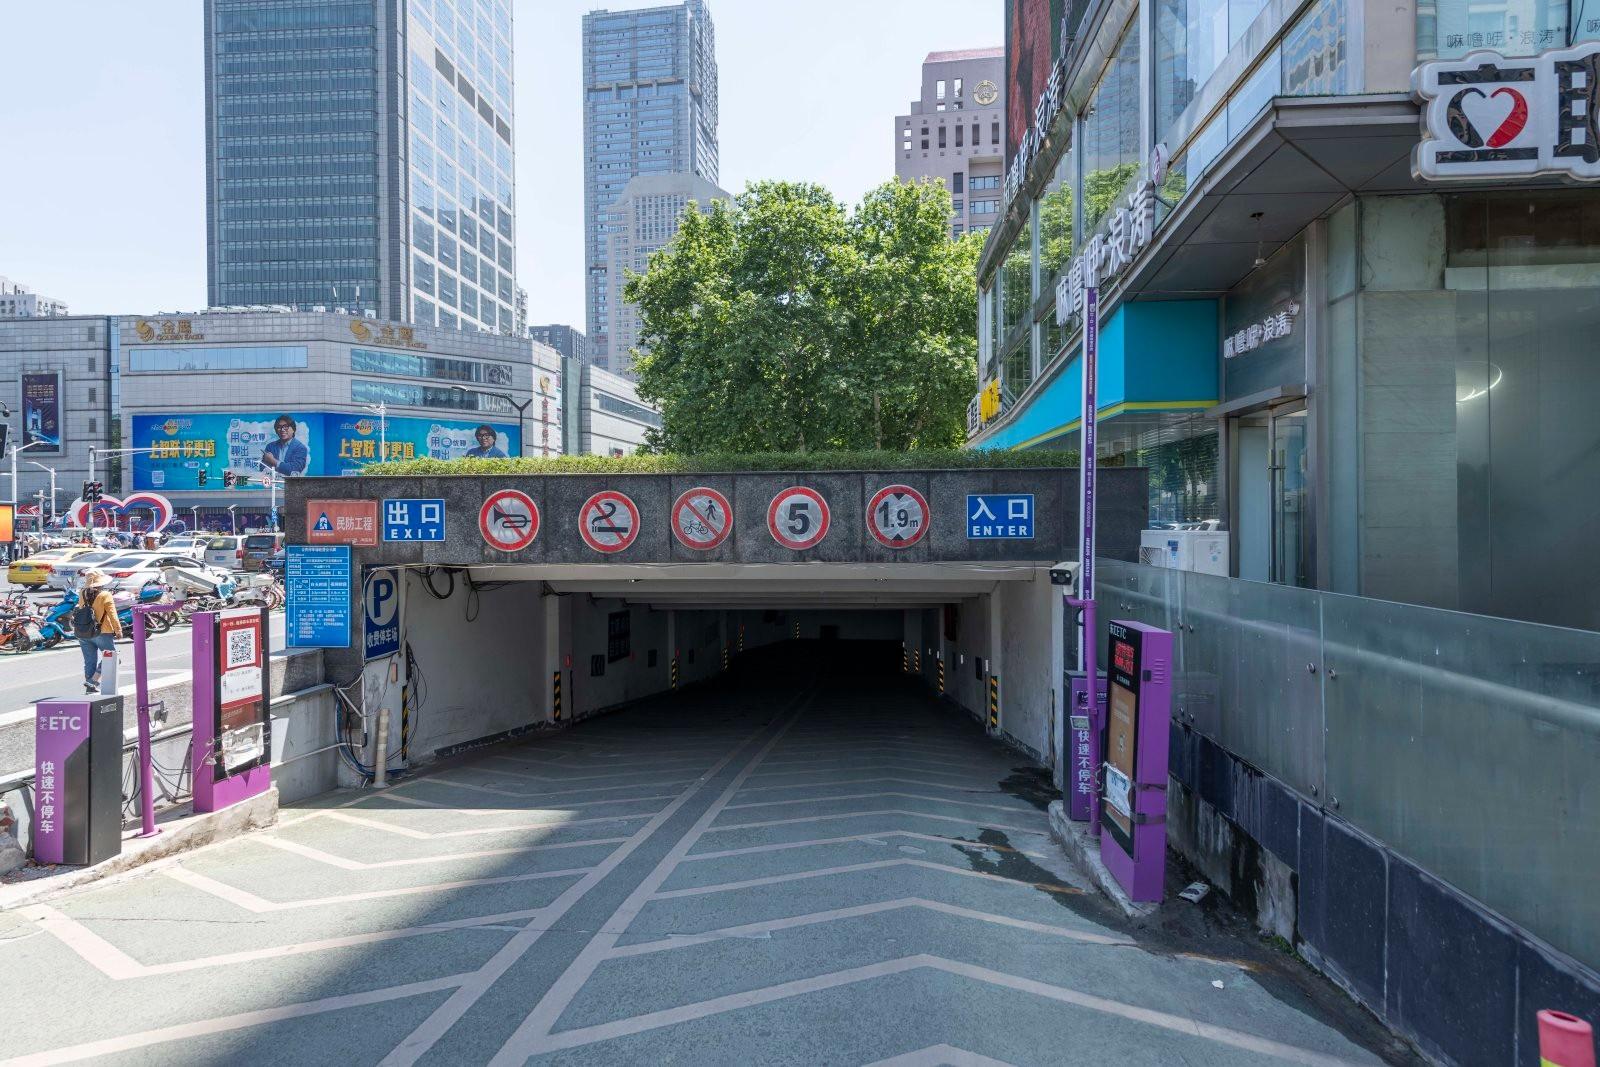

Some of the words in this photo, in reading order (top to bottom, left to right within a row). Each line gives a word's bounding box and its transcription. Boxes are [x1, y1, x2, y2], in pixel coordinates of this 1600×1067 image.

[387, 502, 440, 525] 出口
[787, 503, 811, 535] 5
[971, 497, 1029, 520] 入口
[336, 516, 373, 531] 民防工程
[390, 528, 437, 539] EXIT
[972, 525, 1027, 536] ENTER
[373, 578, 394, 619] P
[366, 626, 398, 649] 收费停车场
[49, 716, 82, 731] ETC
[40, 761, 55, 834] 快速不停车
